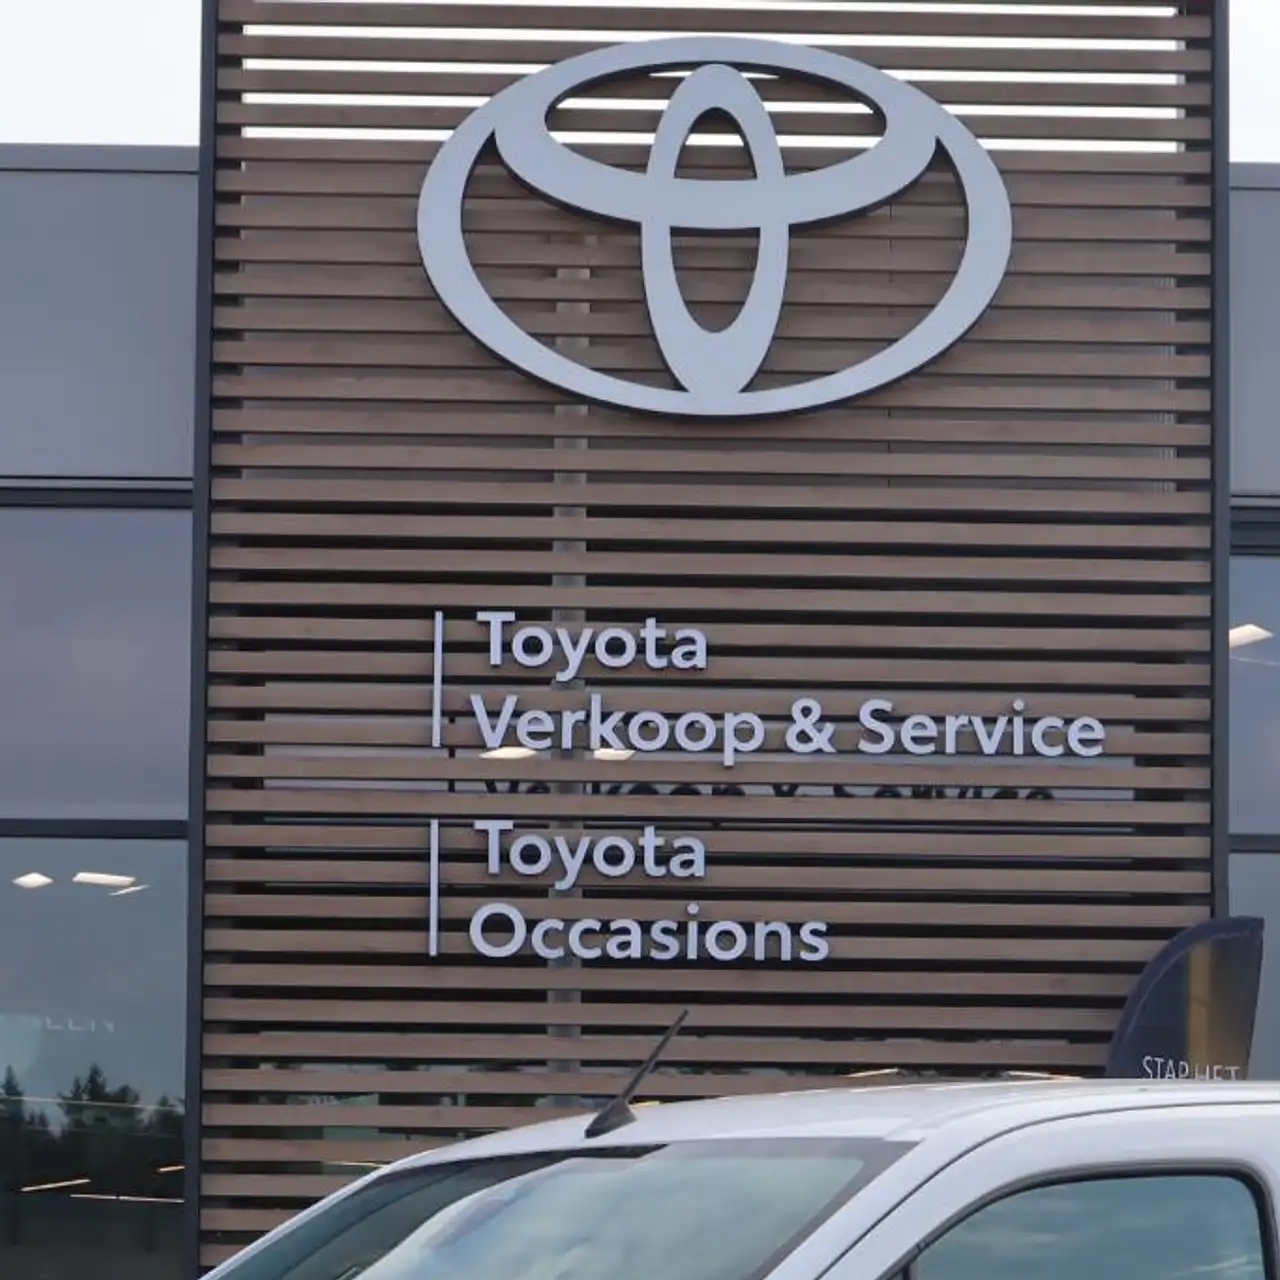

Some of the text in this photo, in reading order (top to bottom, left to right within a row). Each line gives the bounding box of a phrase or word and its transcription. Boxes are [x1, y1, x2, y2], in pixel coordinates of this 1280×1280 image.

[476, 611, 708, 682] Toyota
[470, 693, 1106, 766] Verkoop & Service
[473, 820, 706, 891] Toyota
[469, 903, 830, 961] Occasions
